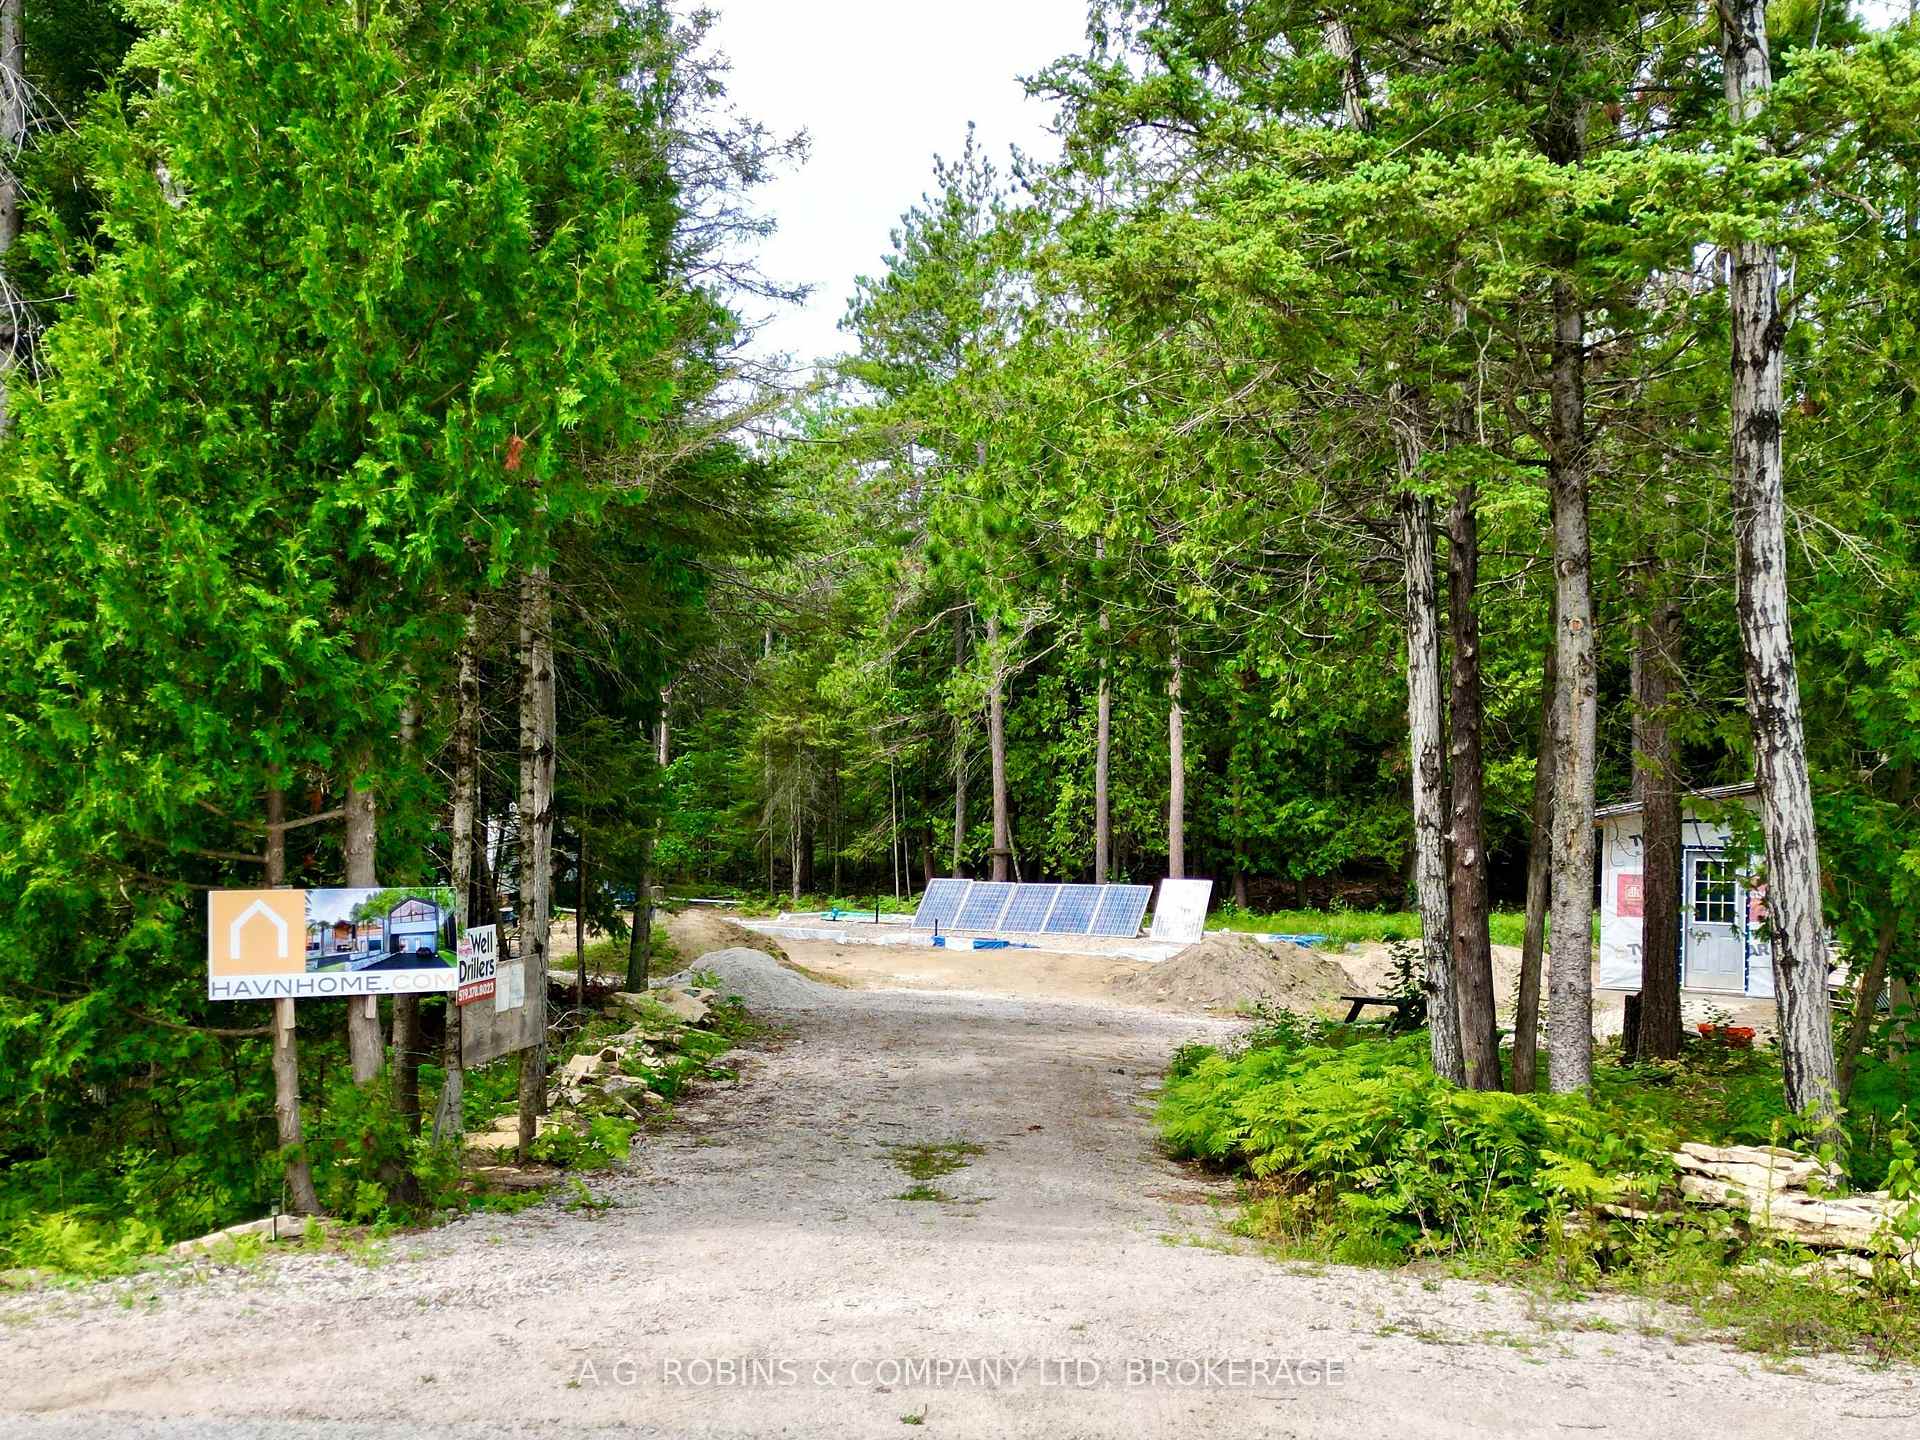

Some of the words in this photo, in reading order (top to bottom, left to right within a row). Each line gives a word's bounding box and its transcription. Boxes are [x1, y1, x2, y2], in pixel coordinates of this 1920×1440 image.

[470, 930, 493, 955] Well
[459, 957, 495, 983] Drillers
[211, 973, 455, 997] HAVNHOME.COM
